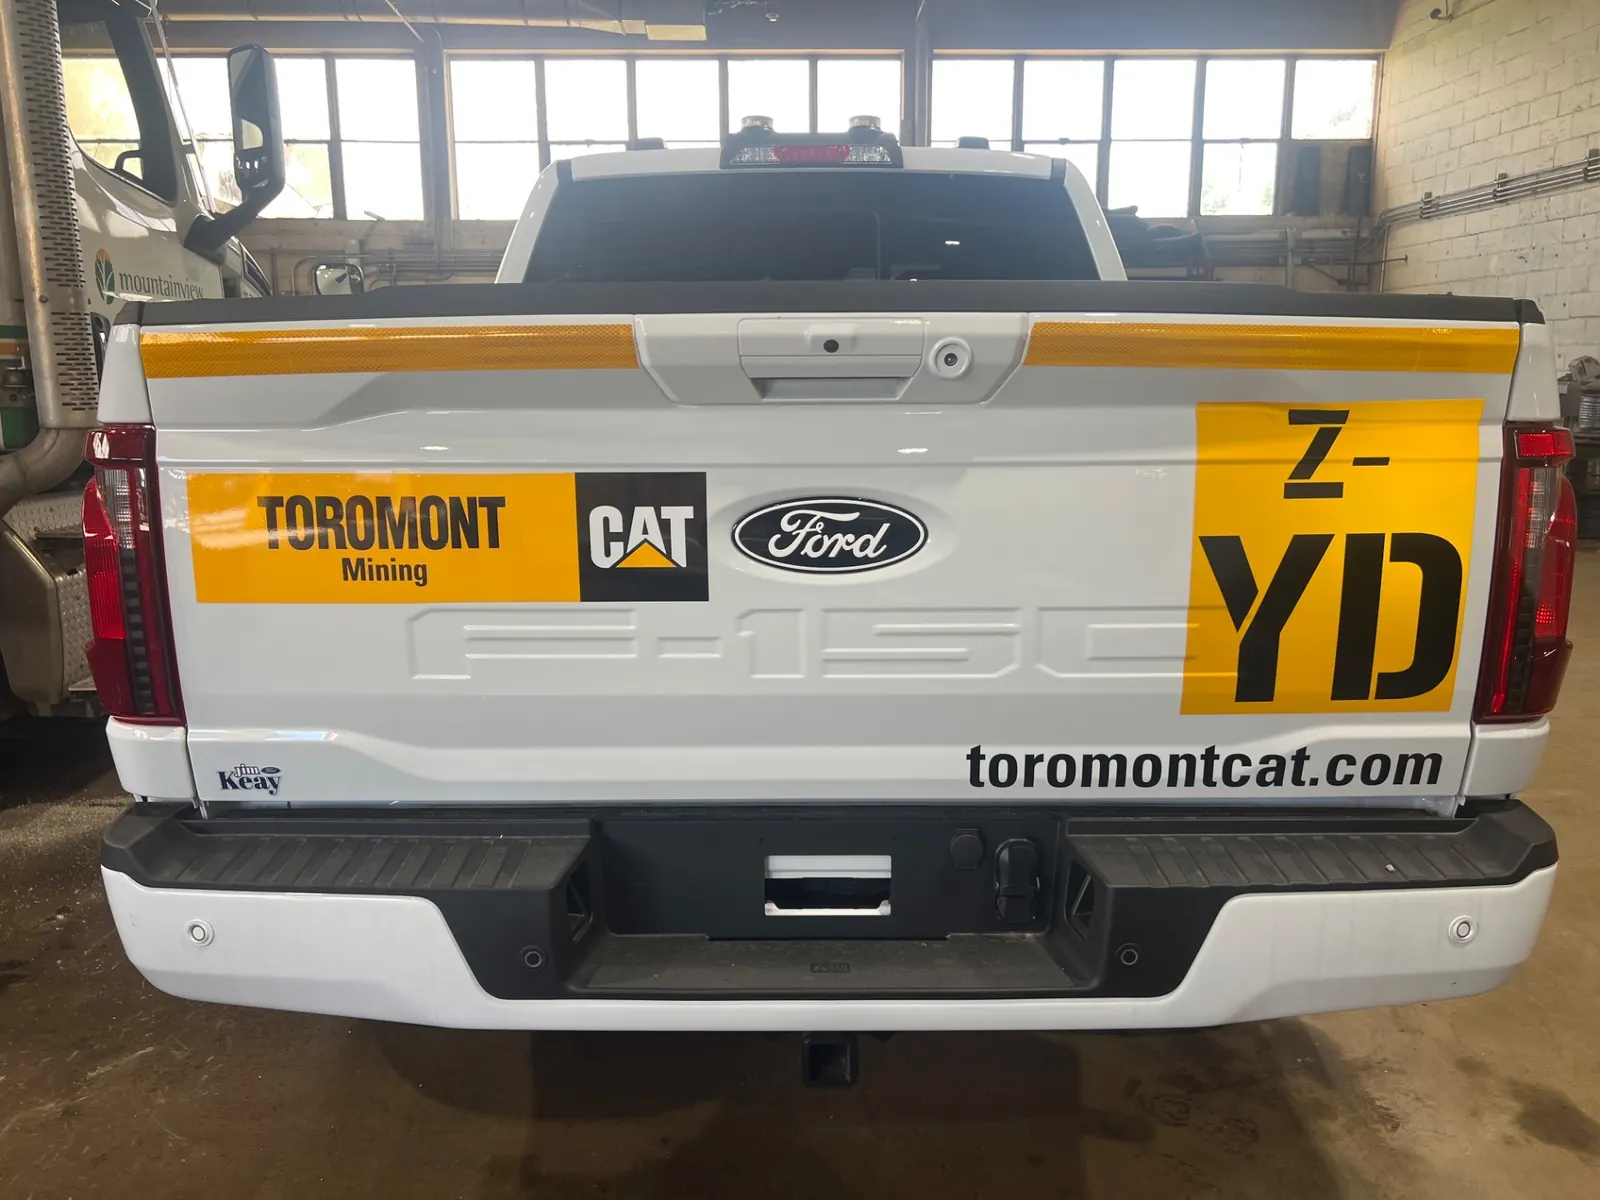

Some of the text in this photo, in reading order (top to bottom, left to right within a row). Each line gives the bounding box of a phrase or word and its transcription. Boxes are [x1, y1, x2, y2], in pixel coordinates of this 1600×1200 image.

[119, 272, 204, 300] mountainview
[256, 495, 506, 551] TOROMONT
[588, 505, 694, 569] CAT
[768, 509, 891, 559] Ford
[341, 557, 428, 587] Mining
[1197, 532, 1463, 703] YD
[217, 771, 281, 795] Keay
[965, 744, 1444, 789] toromontcat.com
